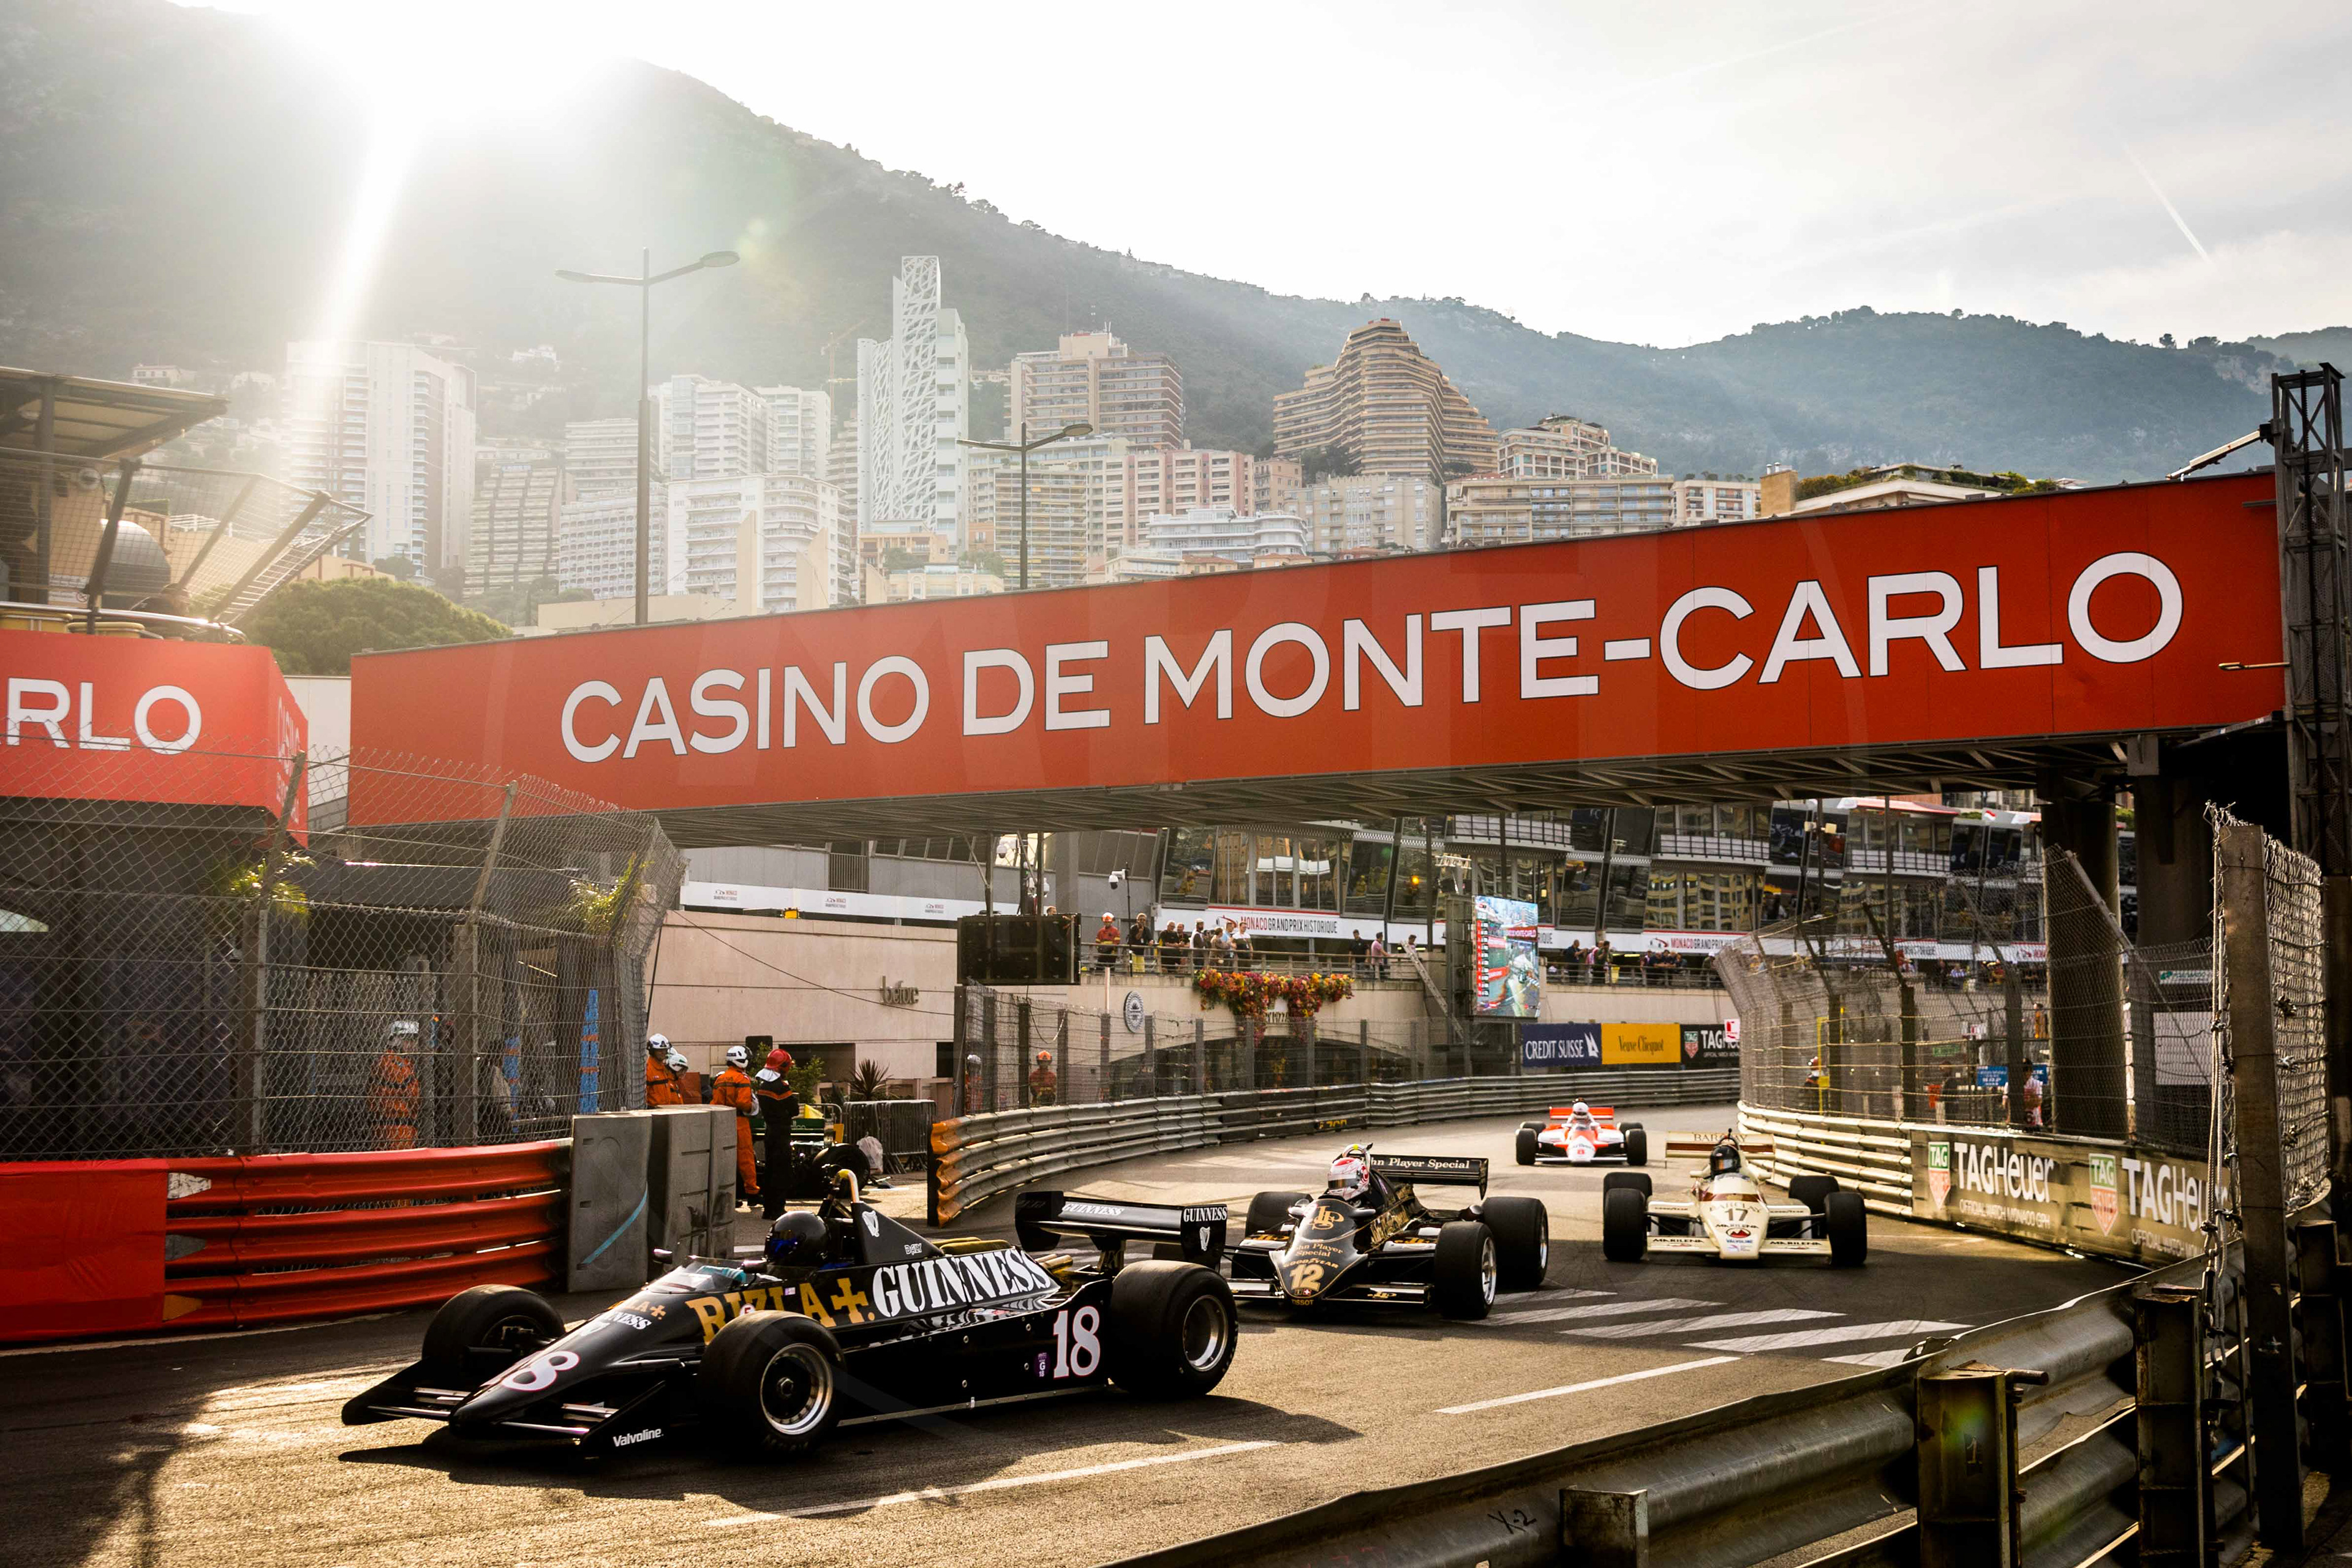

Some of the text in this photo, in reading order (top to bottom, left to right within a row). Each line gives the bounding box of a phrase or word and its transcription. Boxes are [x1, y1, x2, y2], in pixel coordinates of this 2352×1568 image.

[560, 552, 2183, 763] CASINO DE MONTE-CARLO
[1, 677, 202, 755] RLO
[882, 975, 919, 1005] before
[1525, 1039, 1584, 1059] CREDIT SUISSE
[1387, 1158, 1425, 1168] Player
[1427, 1159, 1470, 1169] Special
[1931, 1146, 1948, 1167] TAG
[2090, 1159, 2114, 1186] TAG
[1061, 1202, 1125, 1216] GUINNESS
[1183, 1206, 1227, 1223] GUINNESS
[1724, 1207, 1748, 1221] 17
[1313, 1243, 1344, 1254] Player
[872, 1247, 1052, 1318] GUINNESS
[1289, 1263, 1325, 1292] 12
[1053, 1305, 1101, 1379] 18
[1039, 1362, 1046, 1371] G
[612, 1428, 664, 1447] Valvoline
